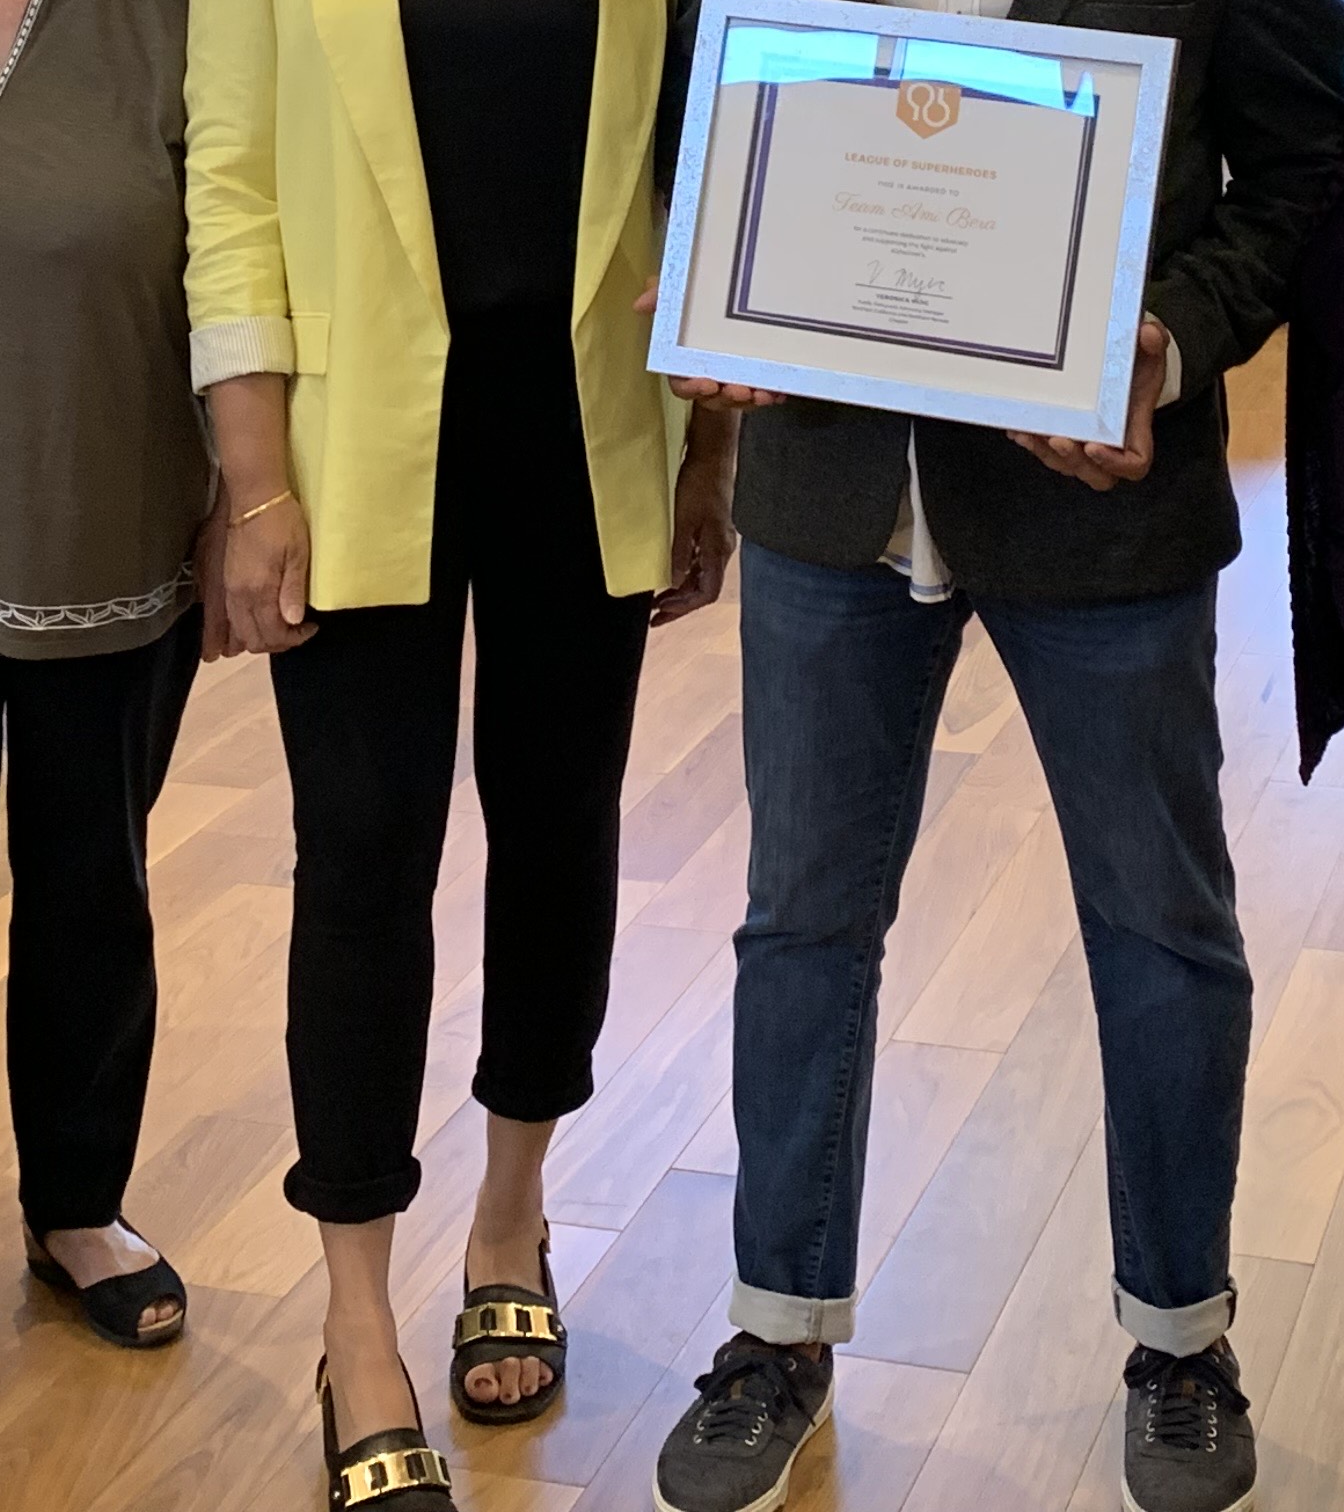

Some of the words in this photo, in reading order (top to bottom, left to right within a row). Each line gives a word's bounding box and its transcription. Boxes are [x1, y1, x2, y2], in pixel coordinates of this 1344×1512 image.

[844, 152, 890, 167] LEAGUE
[893, 158, 907, 168] OF
[911, 160, 998, 180] SUPERHEROES
[832, 191, 885, 215] Team
